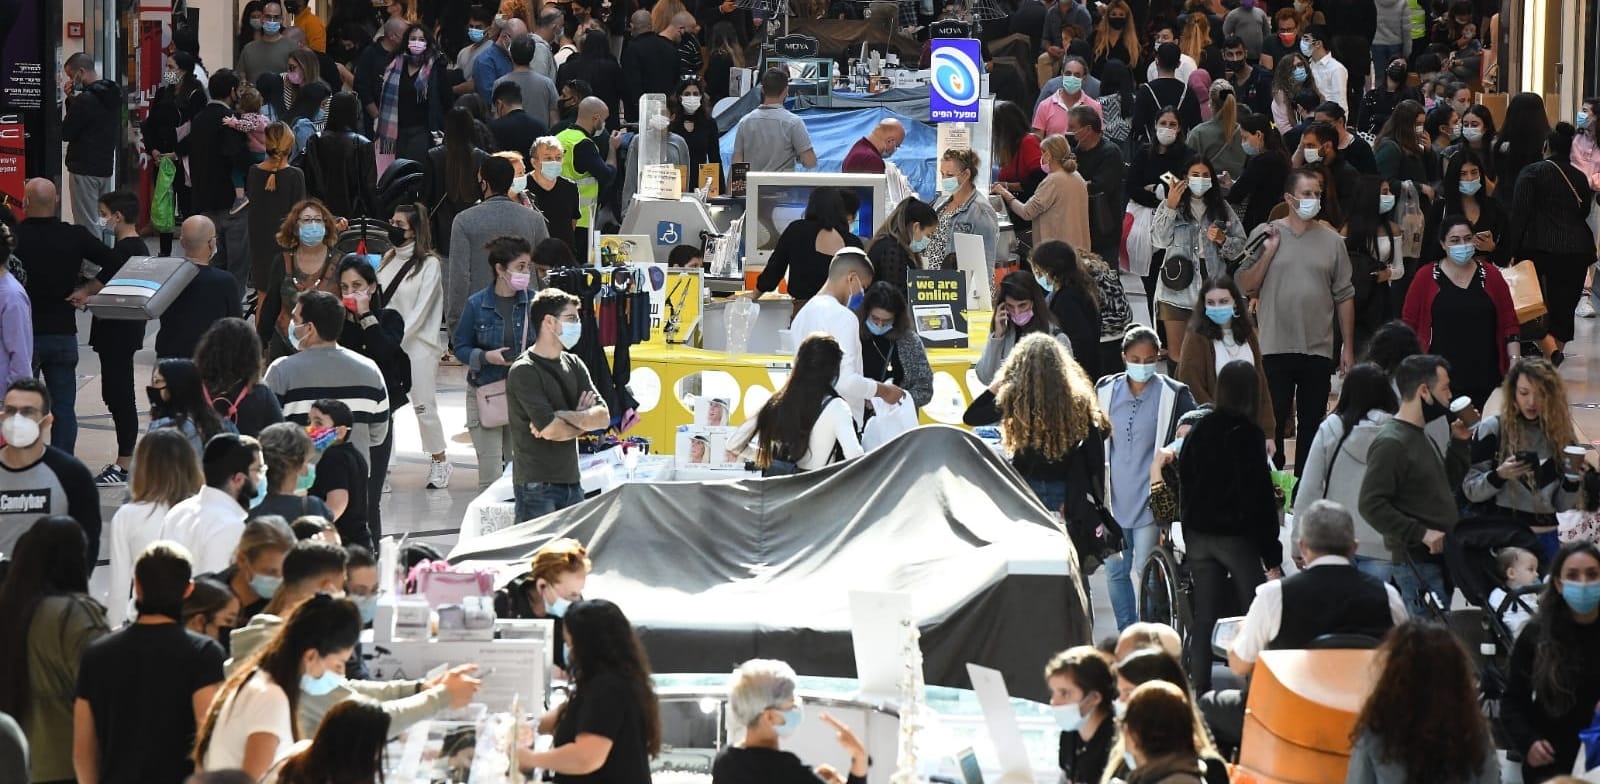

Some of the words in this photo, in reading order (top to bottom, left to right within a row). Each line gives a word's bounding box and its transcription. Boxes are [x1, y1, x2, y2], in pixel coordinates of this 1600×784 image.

[932, 110, 953, 118] הפיס
[953, 109, 977, 119] מפעל
[916, 280, 935, 289] we
[937, 280, 958, 289] are
[917, 290, 959, 301] online
[1, 493, 47, 512] Candybar
